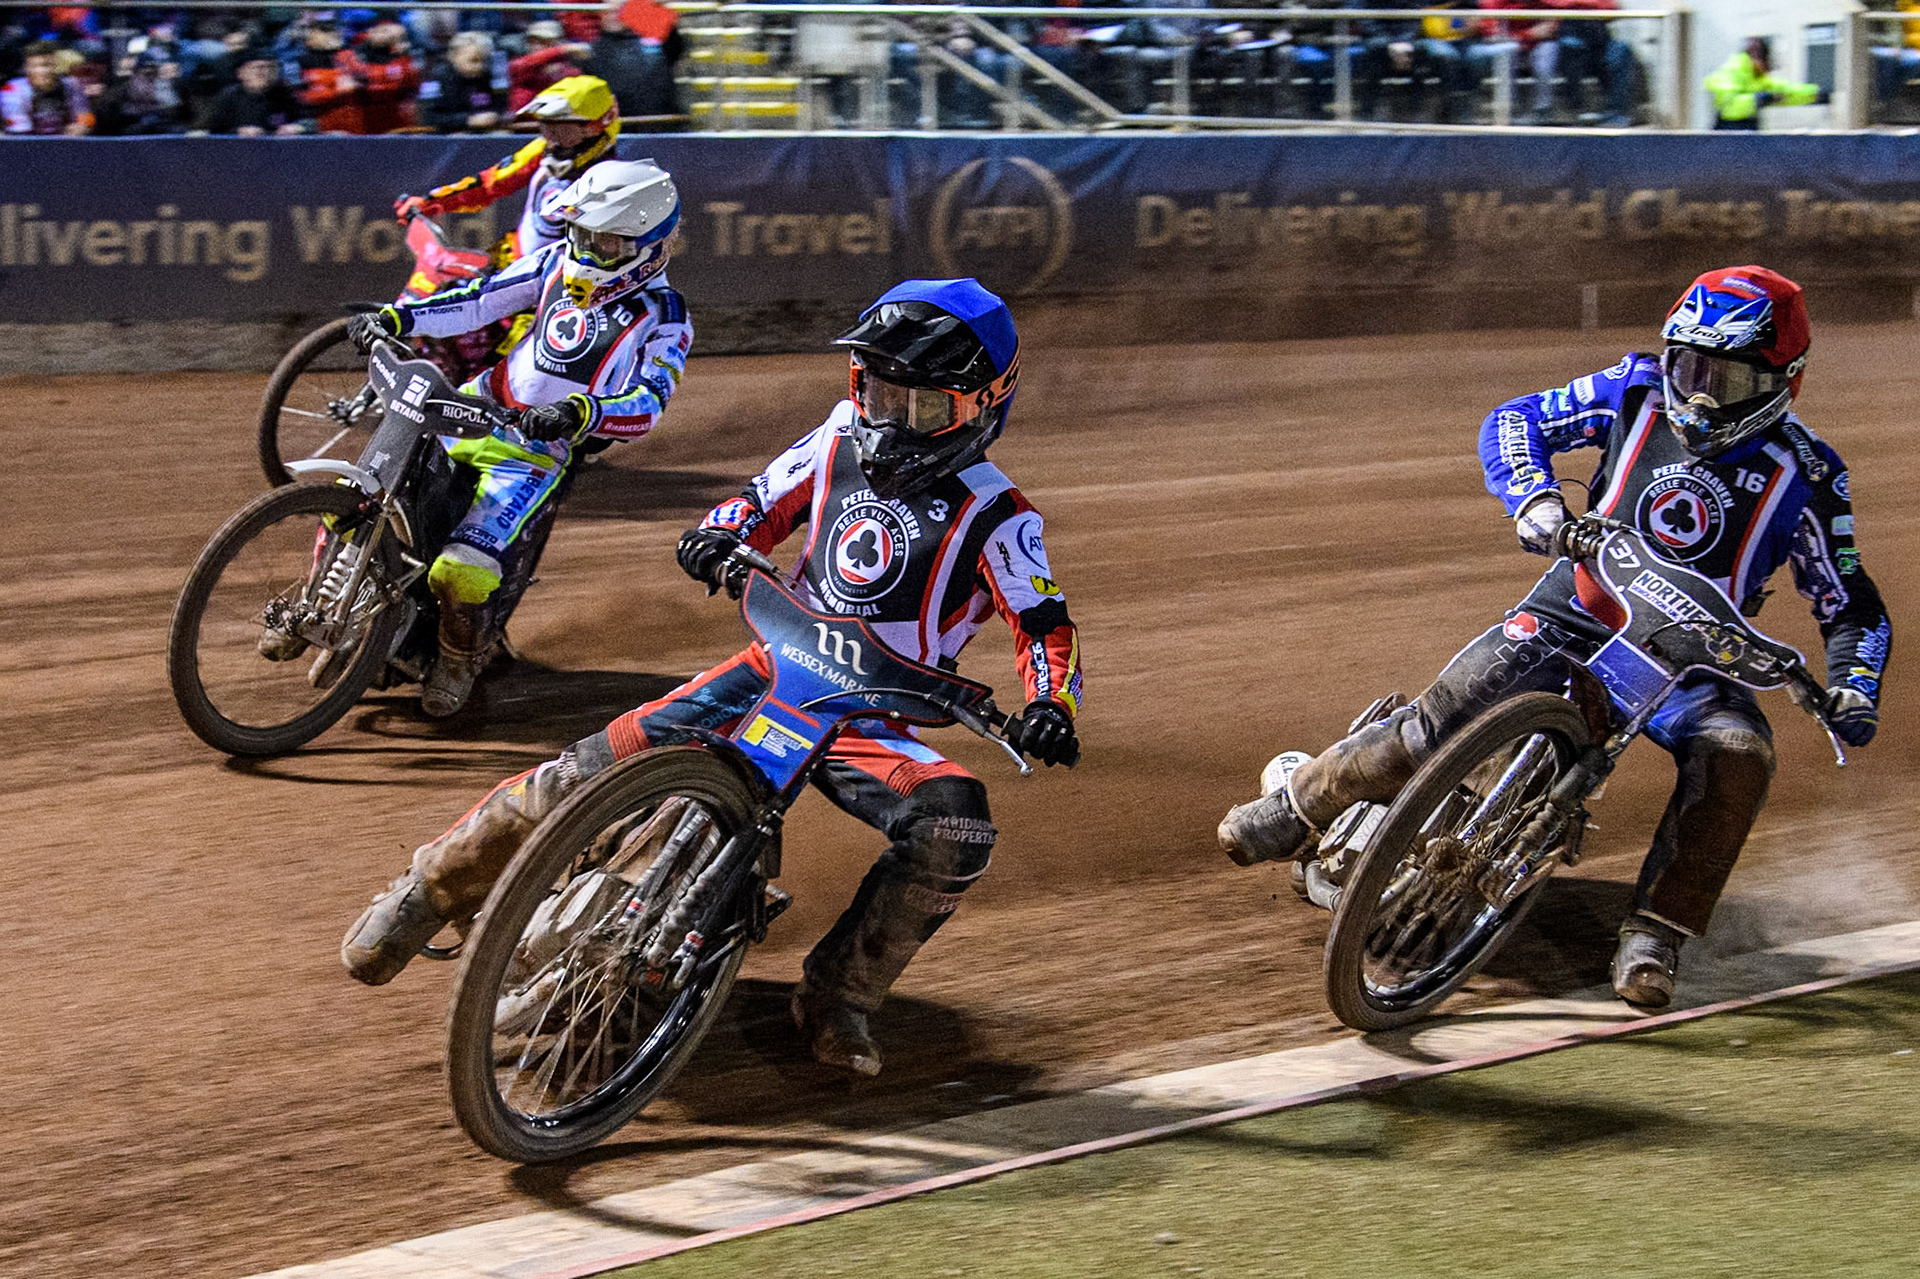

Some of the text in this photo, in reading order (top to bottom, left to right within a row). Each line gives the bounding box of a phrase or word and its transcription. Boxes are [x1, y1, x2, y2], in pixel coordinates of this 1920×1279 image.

[704, 198, 891, 255] Travel
[612, 304, 634, 327] 10
[390, 399, 426, 424] BETARD
[1652, 462, 1735, 509] PETE CRAVEN
[1734, 467, 1768, 494] 16
[497, 476, 542, 530] BETARD
[927, 498, 950, 523] 3
[1649, 479, 1720, 524] BELLE VUE ACES
[837, 507, 904, 558] BELLE VUE ACES
[1607, 538, 1642, 569] 37
[819, 577, 882, 617] MEMORIAL
[780, 642, 828, 677] WESSEX
